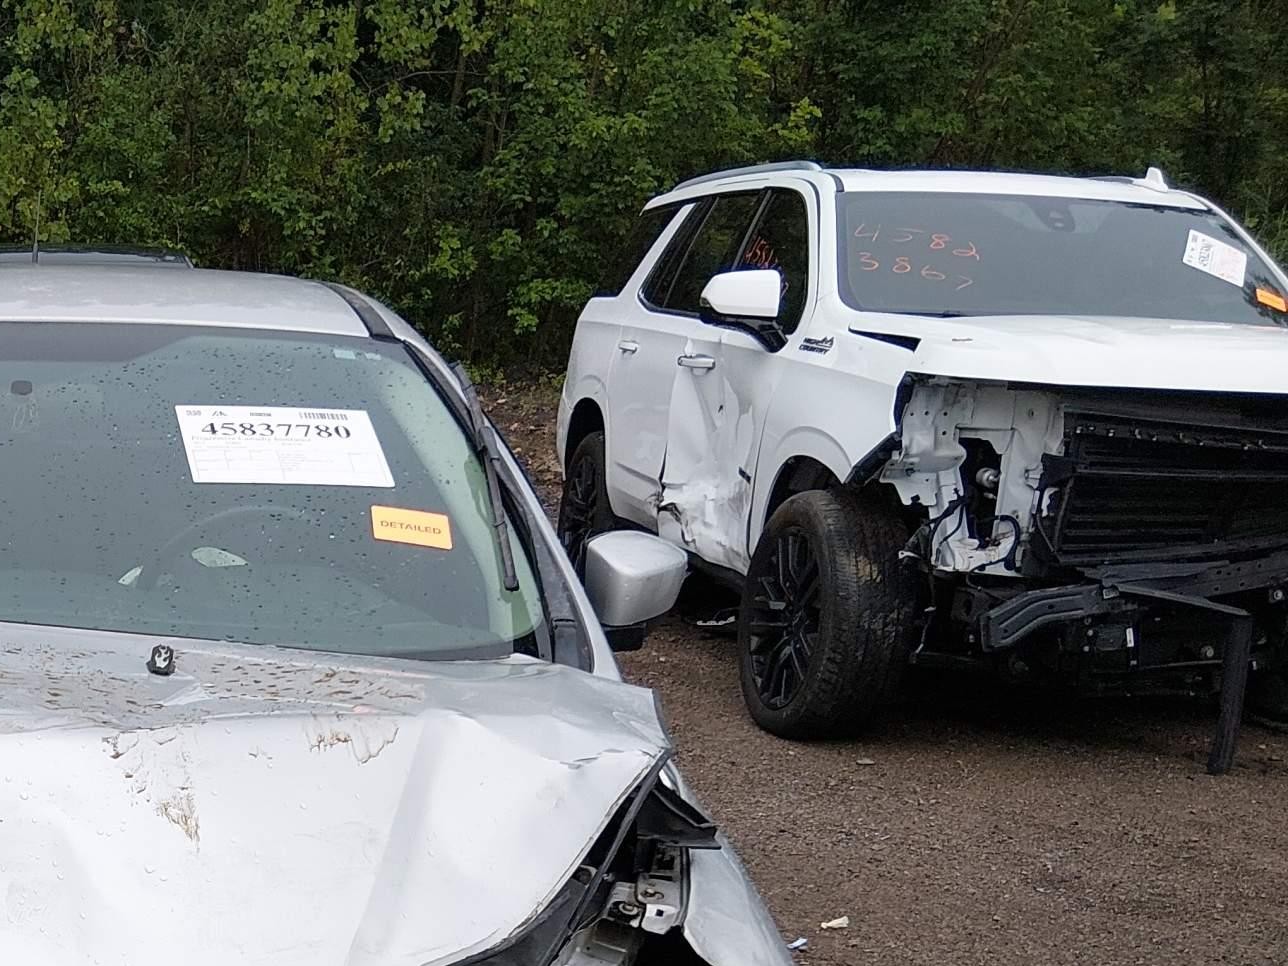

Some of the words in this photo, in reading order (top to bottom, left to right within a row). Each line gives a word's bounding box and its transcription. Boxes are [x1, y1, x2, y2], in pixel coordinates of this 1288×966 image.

[854, 223, 980, 261] 4582
[200, 421, 351, 439] 45837780
[380, 519, 442, 536] DETAILED
